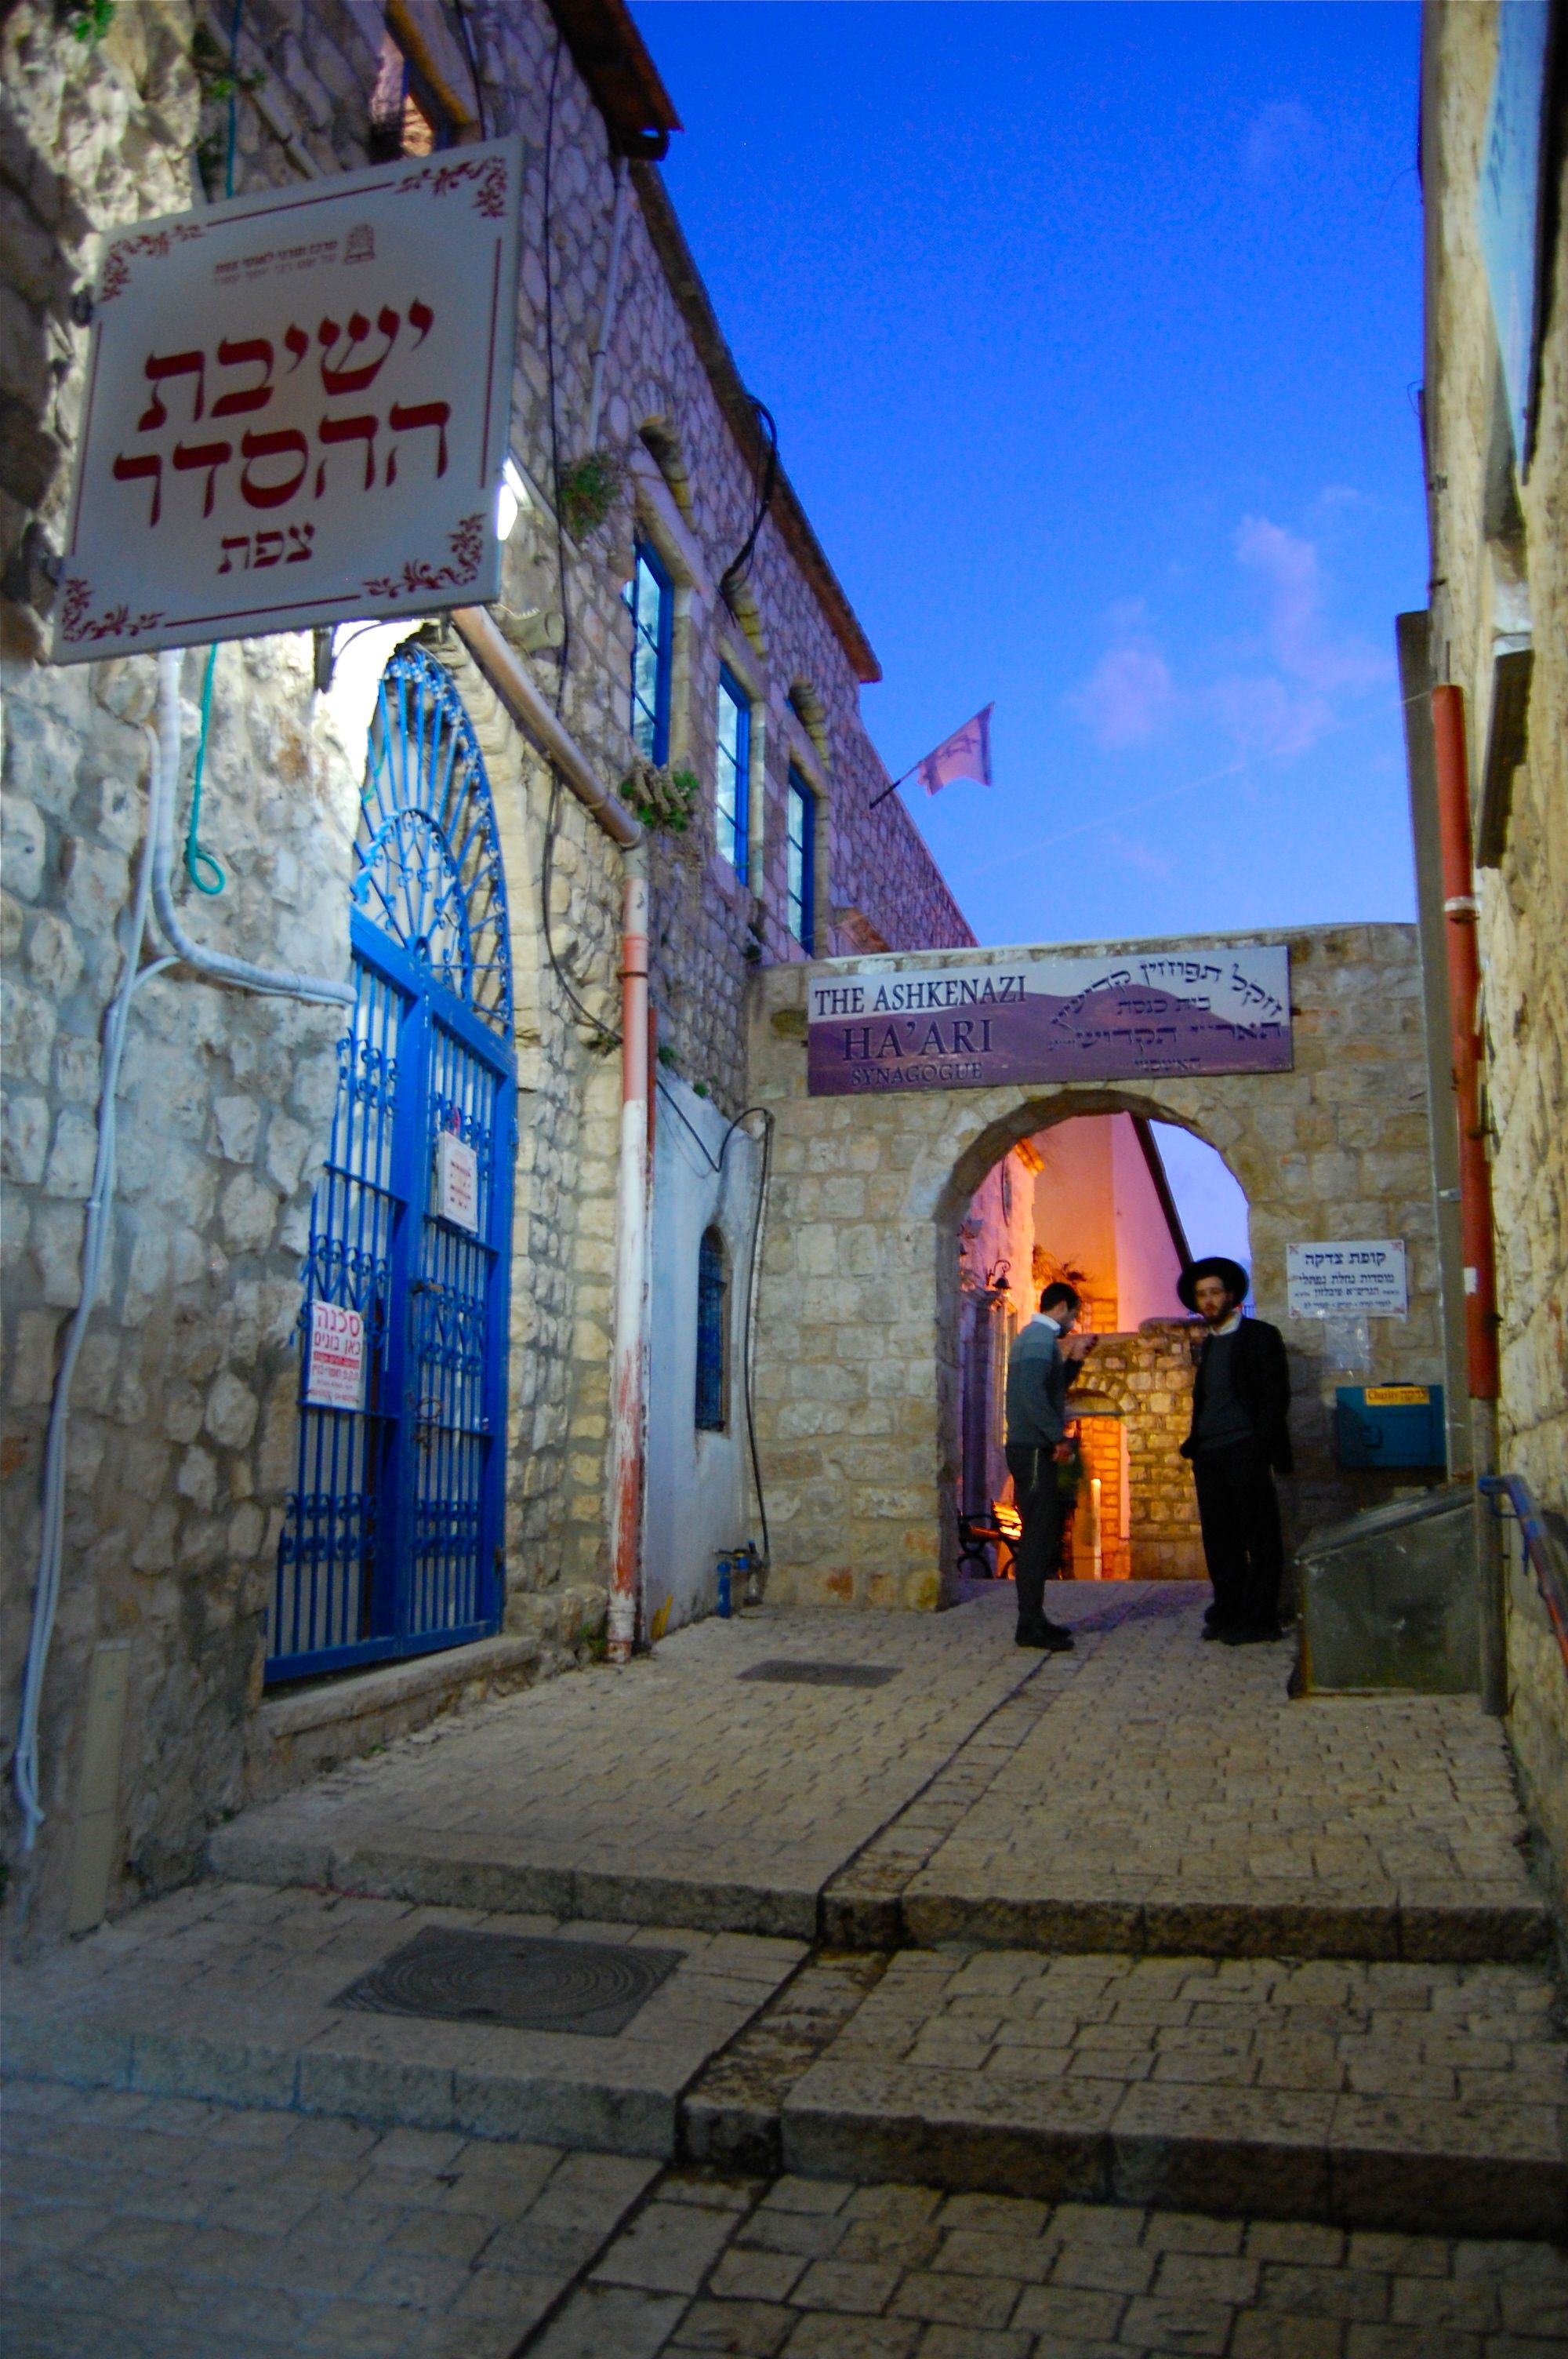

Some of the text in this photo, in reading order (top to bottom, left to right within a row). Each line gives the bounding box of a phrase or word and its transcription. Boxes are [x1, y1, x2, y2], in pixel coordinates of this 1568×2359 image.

[138, 298, 434, 431] ישיבת
[112, 399, 451, 527] ההסדר
[218, 522, 316, 575] צפת
[815, 975, 1027, 1016] THE ASHKENAZI
[1117, 996, 1210, 1015] בית כנסת
[842, 1019, 994, 1060] HA'ARI
[1075, 1026, 1177, 1054] הקדוש
[851, 1062, 983, 1086] SYNAGOGUE
[1305, 1252, 1387, 1268] קופת צדקה
[318, 1305, 360, 1338] סכנה
[314, 1331, 361, 1356] כאן בונים
